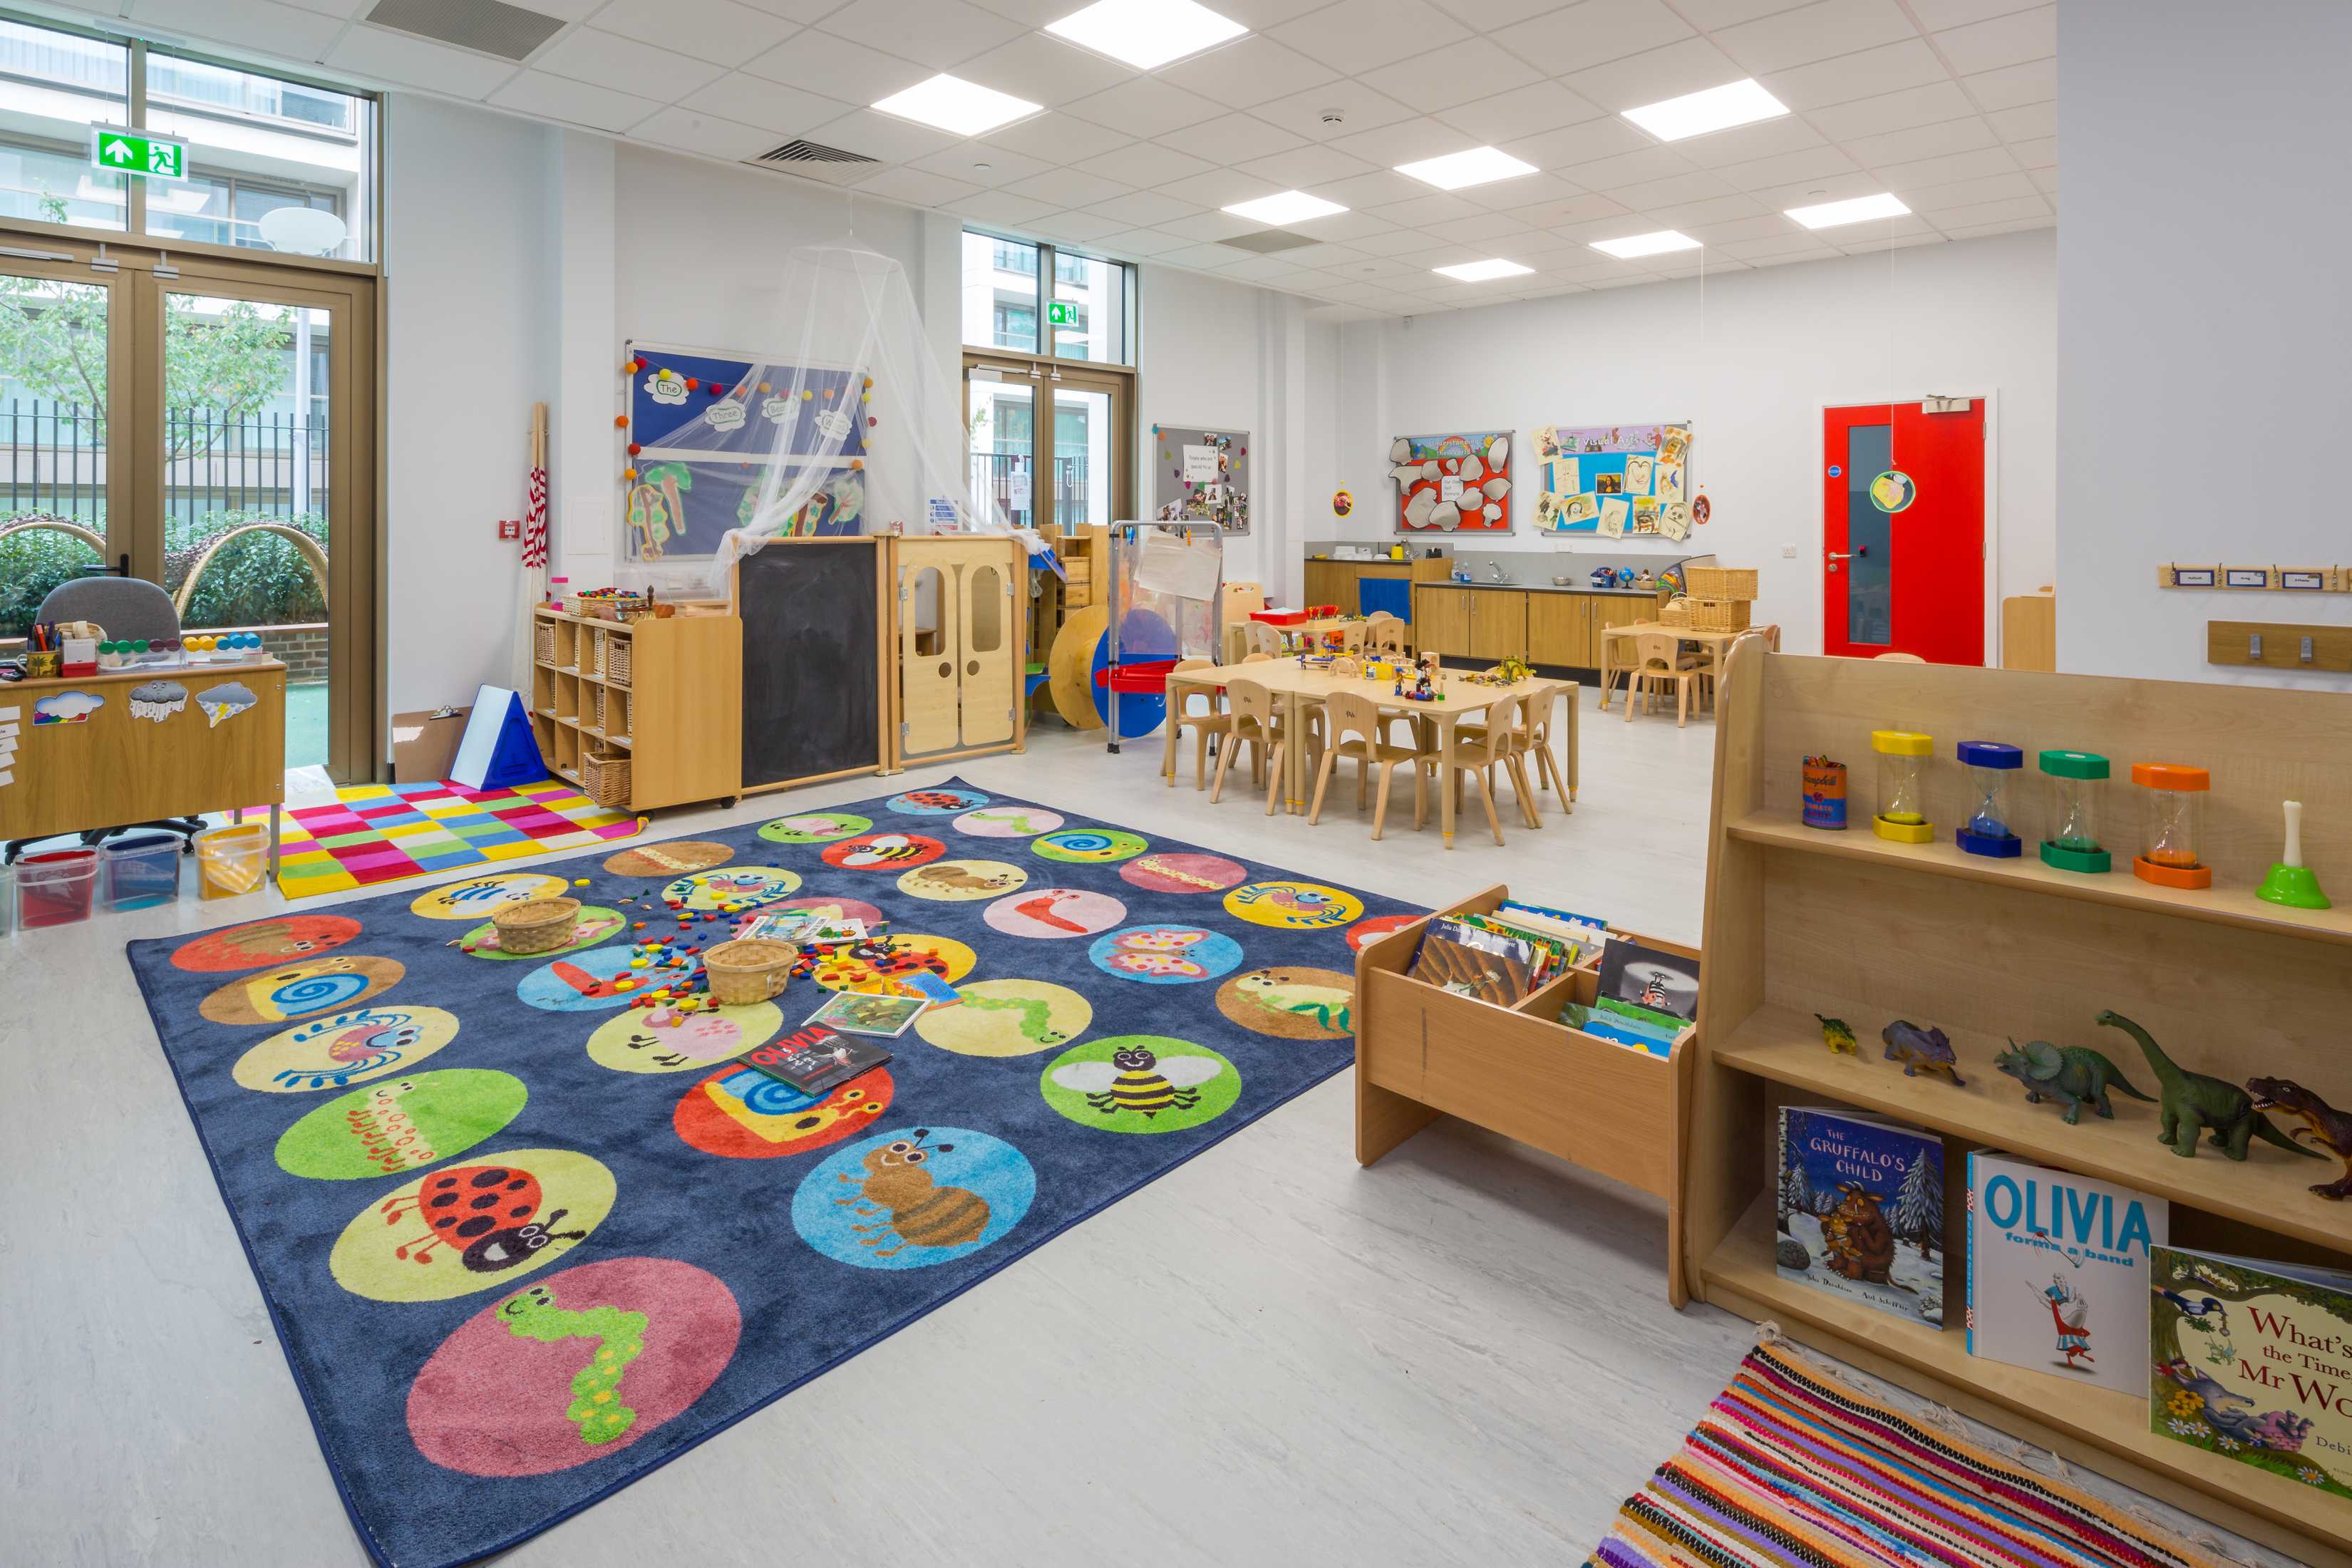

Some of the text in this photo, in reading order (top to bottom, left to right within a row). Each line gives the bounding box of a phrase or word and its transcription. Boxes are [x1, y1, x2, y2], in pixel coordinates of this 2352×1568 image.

[659, 383, 677, 393] The
[712, 410, 738, 421] Three
[1582, 433, 1639, 446] Visual Arts
[1440, 923, 1452, 932] Julia
[751, 1025, 838, 1066] OLIVIA
[1826, 1128, 1845, 1141] THE
[1810, 1137, 1906, 1172] GRUFFALO'S
[1835, 1160, 1883, 1182] CHILD
[1984, 1174, 2153, 1259] OLIVIA
[2005, 1232, 2135, 1268] forms a band
[2247, 1306, 2352, 1359] What's
[2262, 1345, 2293, 1364] the
[2238, 1358, 2285, 1390] Mr
